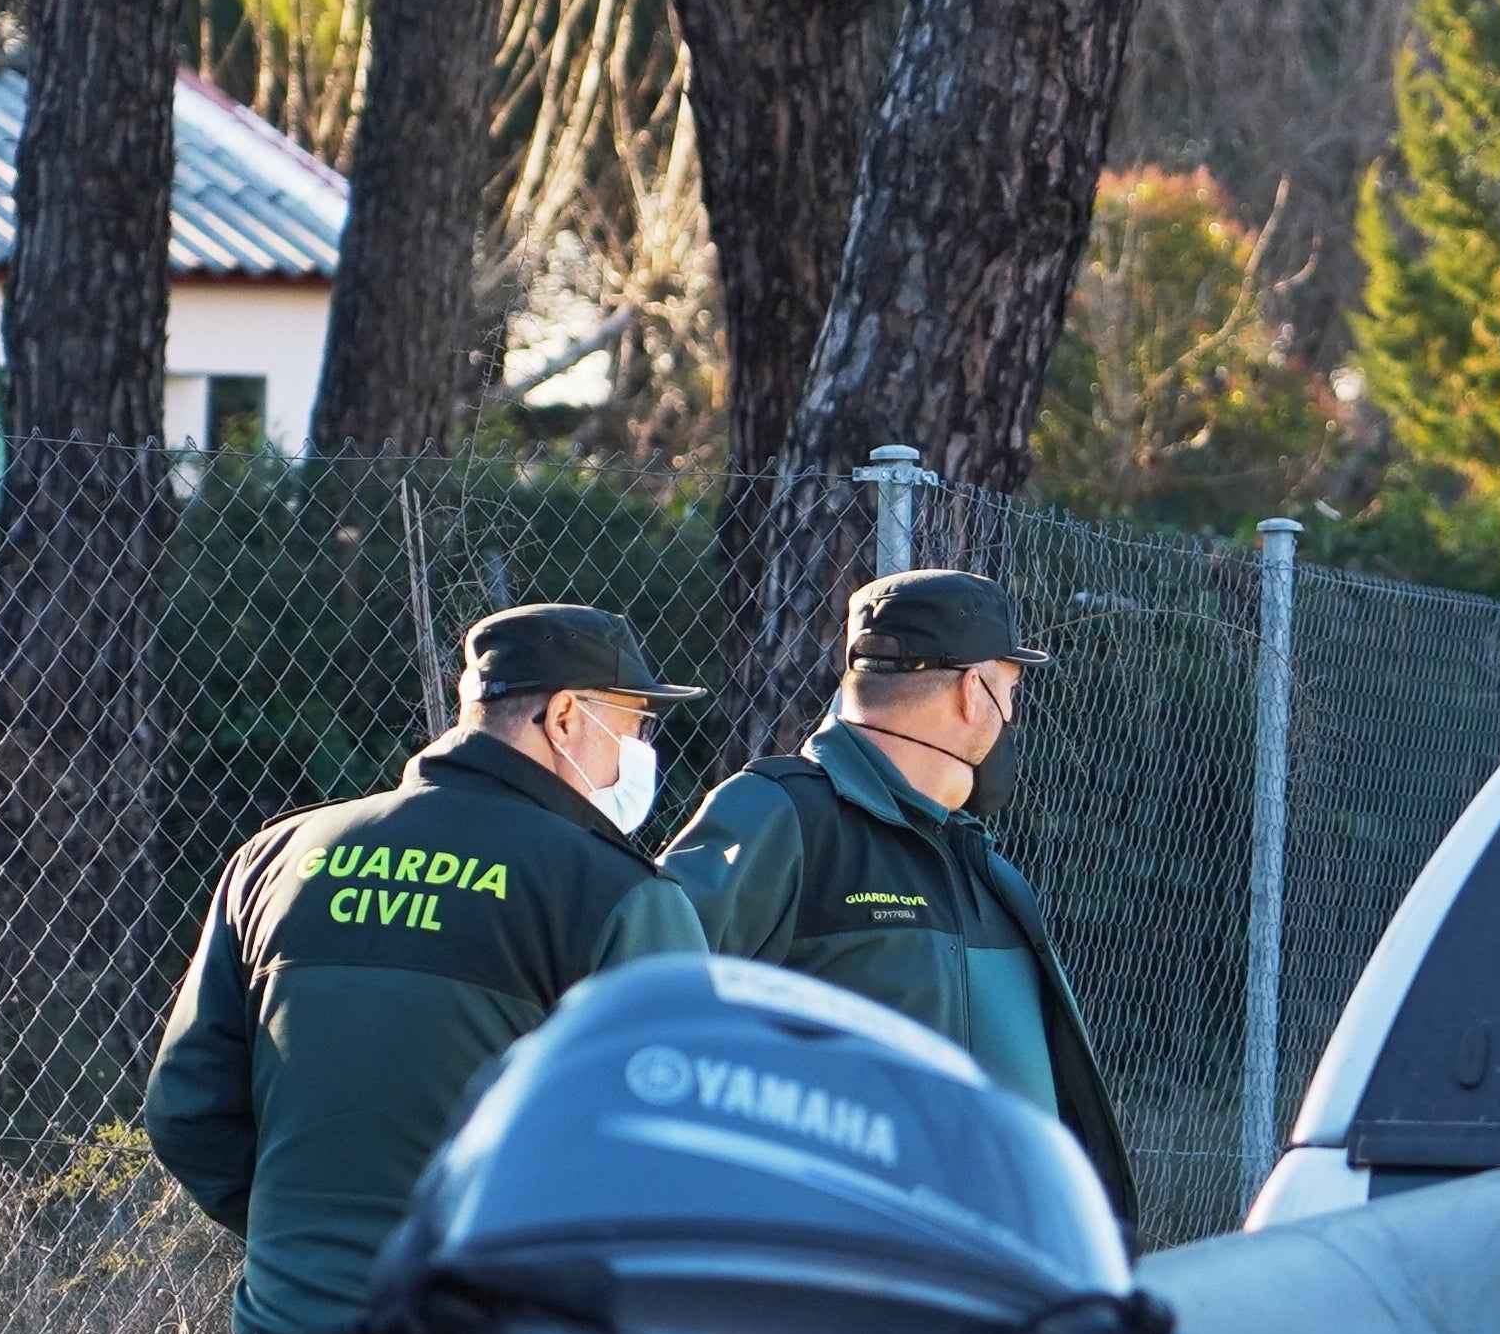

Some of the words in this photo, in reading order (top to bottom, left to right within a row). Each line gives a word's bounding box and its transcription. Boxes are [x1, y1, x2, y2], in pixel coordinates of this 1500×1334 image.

[296, 844, 508, 901] GUARDIA
[329, 886, 442, 931] CIVIL
[845, 892, 899, 904] GUARDIA
[900, 895, 928, 907] CIVIL
[694, 1054, 899, 1168] YAMAHA
